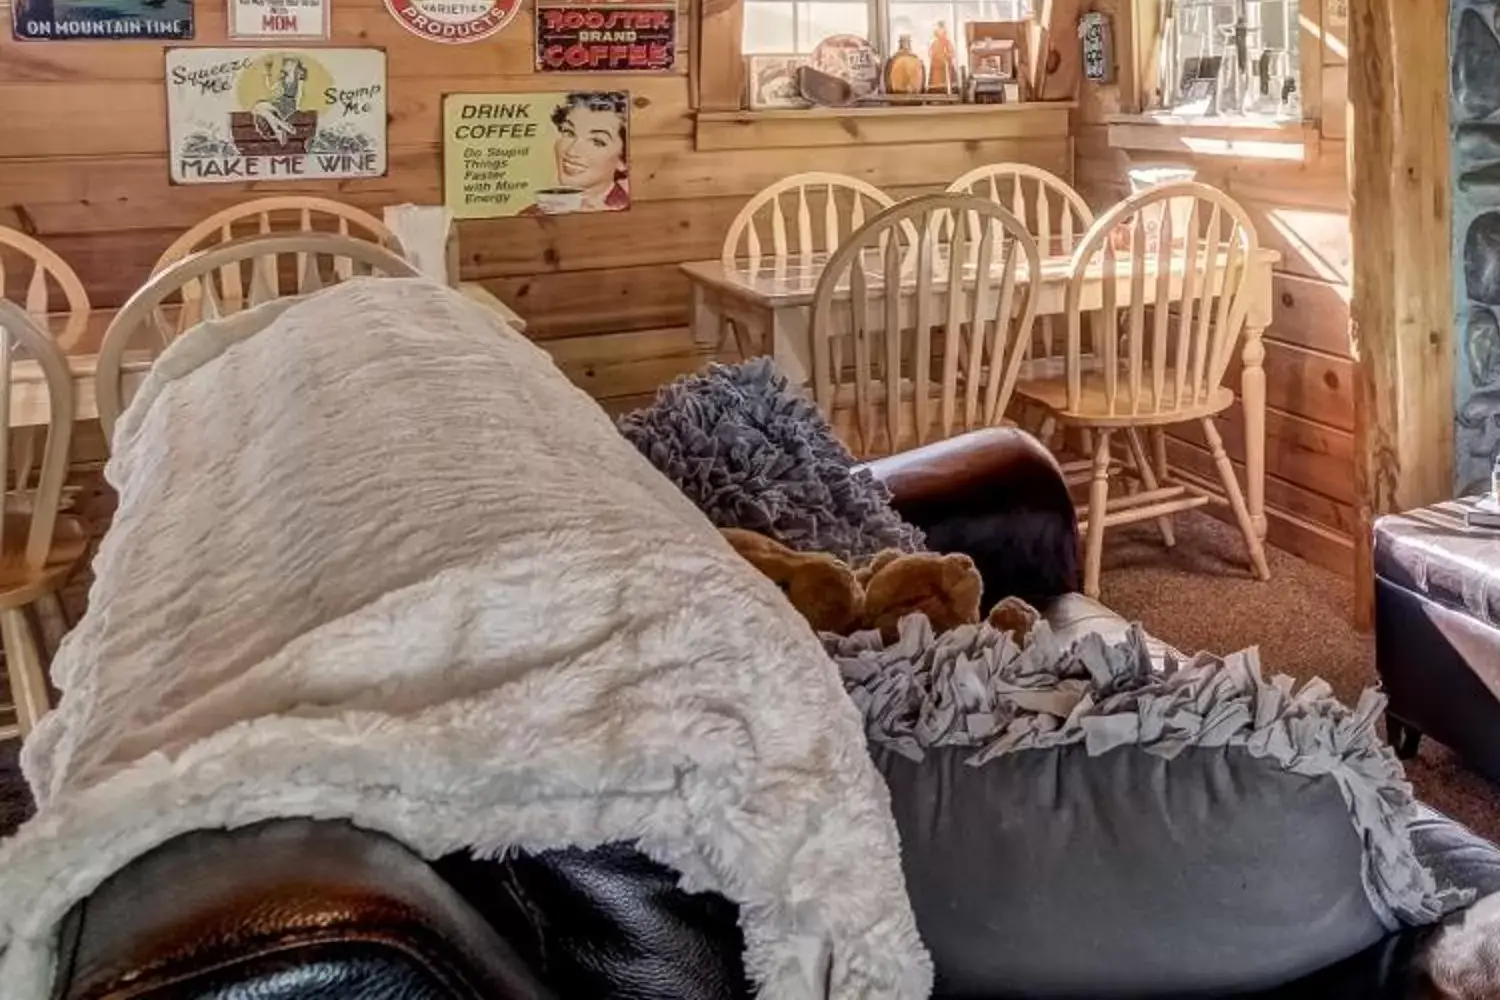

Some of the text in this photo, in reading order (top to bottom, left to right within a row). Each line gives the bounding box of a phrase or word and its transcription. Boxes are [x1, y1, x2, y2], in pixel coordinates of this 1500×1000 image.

[422, 3, 487, 14] VARIETIES
[27, 20, 182, 35] ON MOUNTAIN TIME
[262, 15, 298, 30] MOM
[401, 7, 505, 36] PRODUCTS
[543, 10, 669, 30] ROOSTER
[579, 31, 637, 42] BRAND
[544, 45, 671, 68] COFFEE
[171, 57, 254, 86] Squeeze
[201, 77, 233, 95] Me
[323, 83, 381, 105] Stomp
[343, 102, 371, 116] Me
[461, 103, 532, 120] DRINK
[455, 123, 539, 139] COFFEE
[463, 147, 530, 159] Do Stupid
[180, 153, 377, 177] MAKE ME WINE
[463, 159, 509, 171] Things
[463, 170, 507, 181] Faster
[463, 180, 529, 192] with More
[464, 193, 511, 205] Energy
